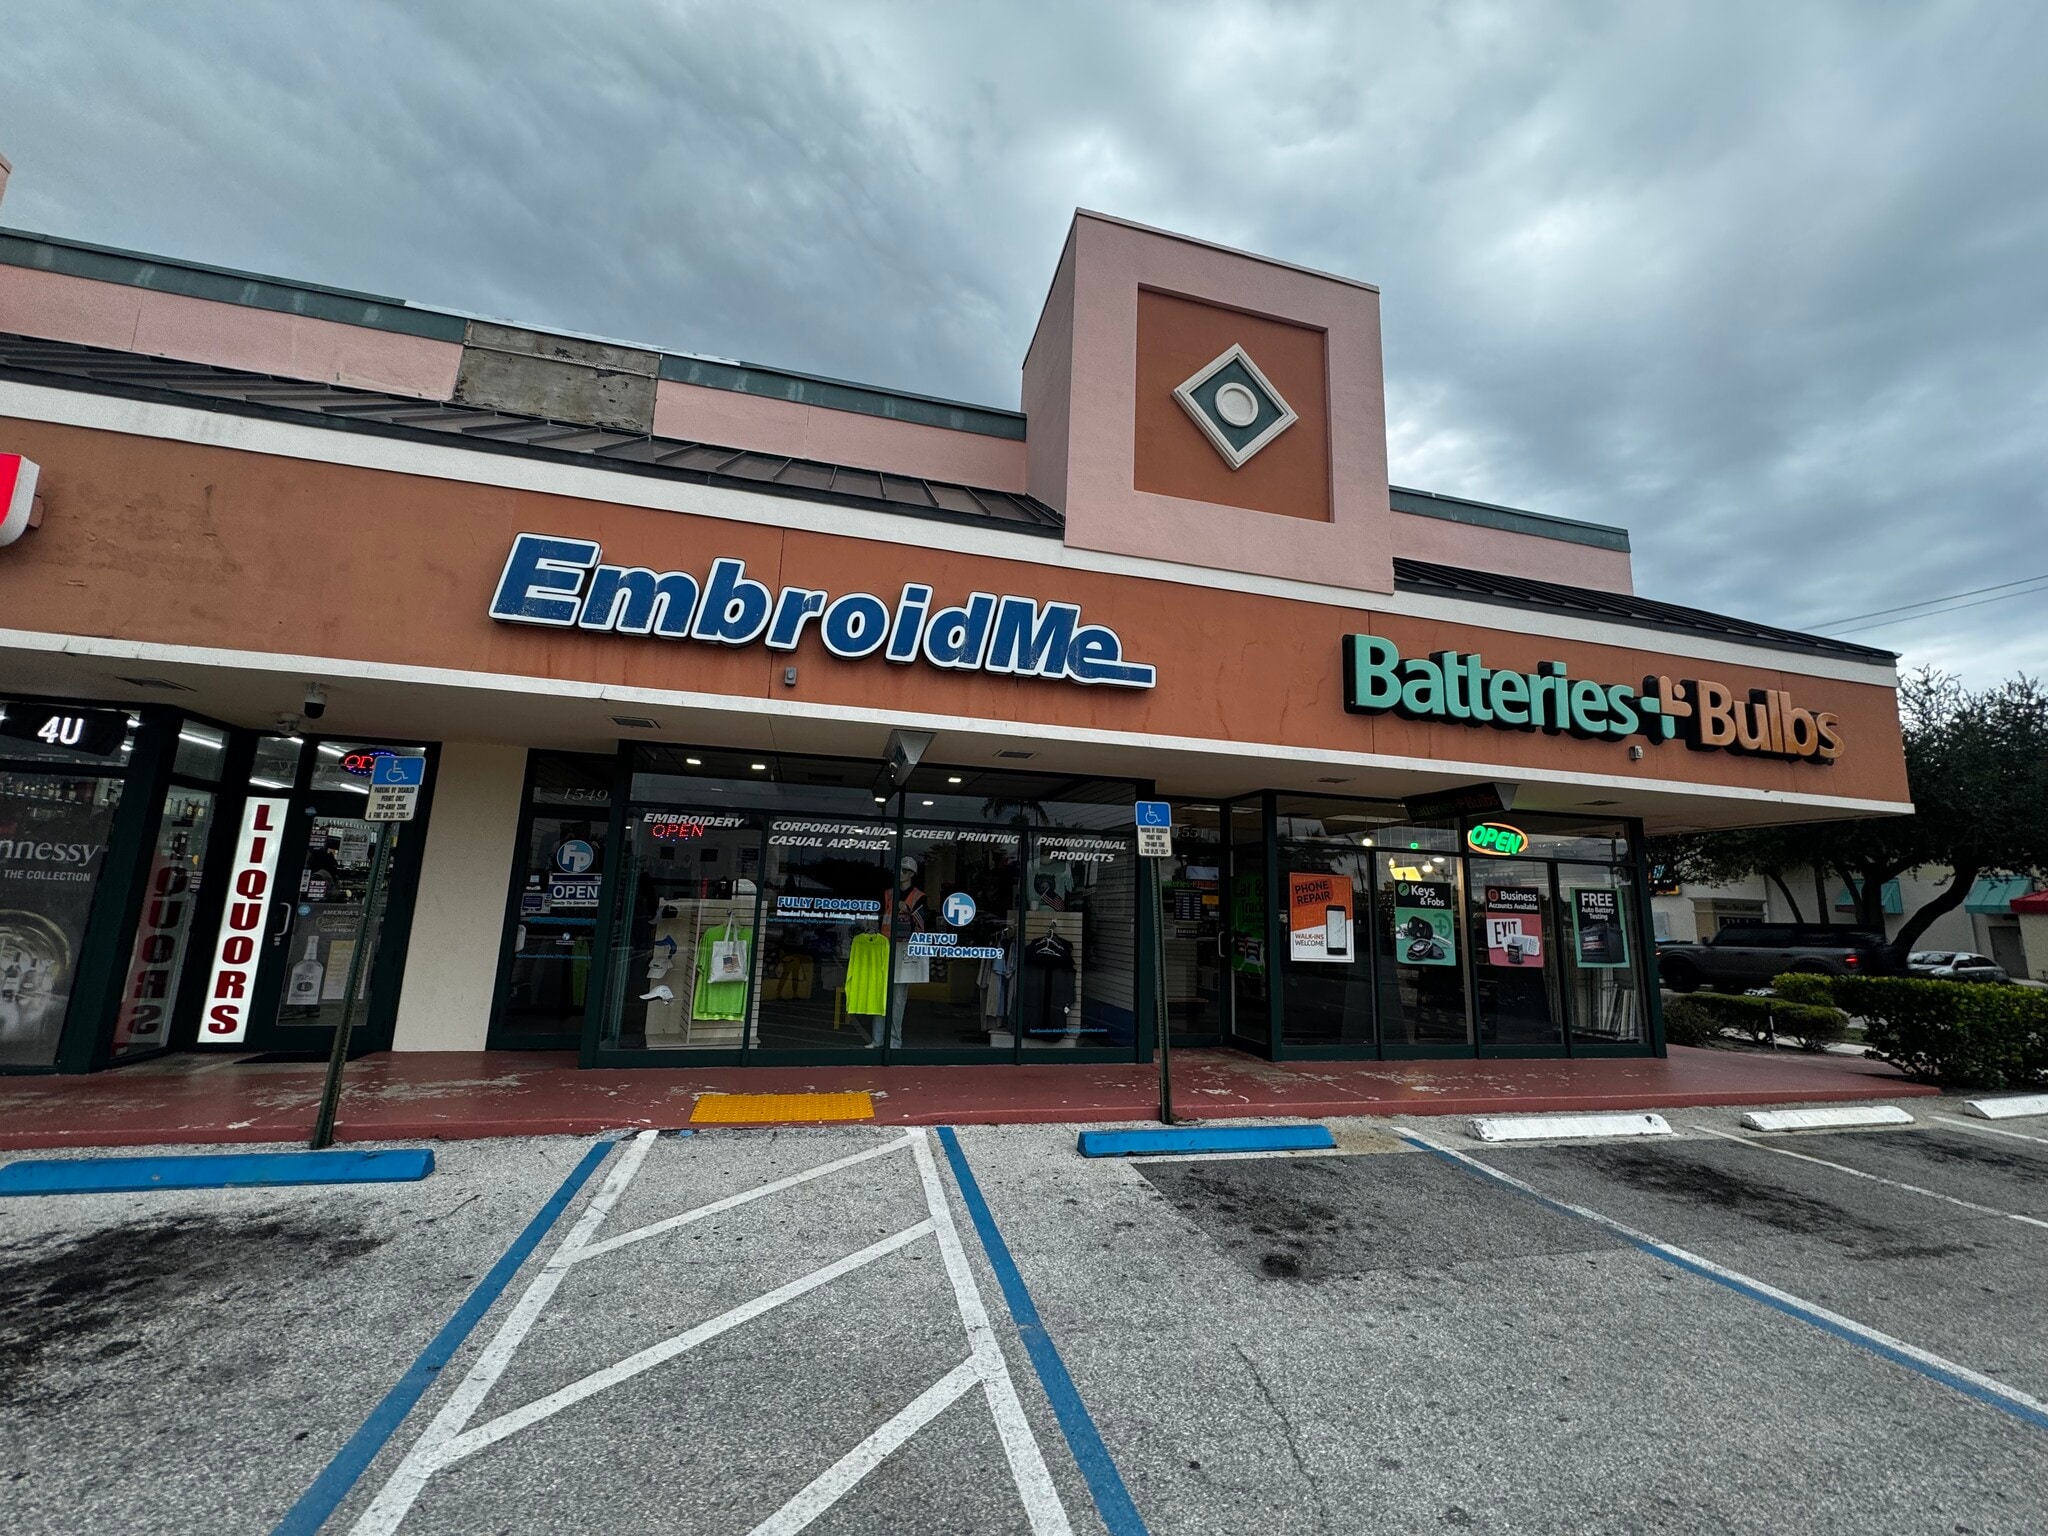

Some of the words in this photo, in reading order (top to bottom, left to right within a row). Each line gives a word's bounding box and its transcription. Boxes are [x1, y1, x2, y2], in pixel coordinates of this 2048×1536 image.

[489, 533, 1156, 689] EmbroidMe
[1346, 634, 1639, 740] Batteries
[1697, 679, 1846, 760] Bulbs
[37, 716, 84, 745] 4U
[564, 788, 608, 801] 1549
[643, 812, 745, 828] EMBROIDERY
[652, 824, 705, 838] OPEN
[772, 821, 859, 835] CORPORATE
[860, 826, 892, 837] AND
[903, 828, 956, 841] SCREEN
[957, 832, 1020, 844] PRINTING
[768, 835, 824, 847] CASUAL
[827, 838, 892, 851] APPAREL
[1037, 836, 1127, 850] PROMOTIONAL
[1471, 825, 1522, 855] OPEN
[1049, 850, 1115, 863] PRODUCTS
[4, 869, 25, 879] THE
[26, 870, 92, 882] COLLECTION
[552, 885, 598, 898] OPEN
[1294, 880, 1330, 895] PHONE
[1411, 884, 1436, 898] Keys
[1296, 891, 1331, 905] REPAIR
[1420, 898, 1426, 906] &
[1427, 898, 1445, 906] Fobs
[1500, 890, 1537, 902] Business
[1581, 892, 1614, 907] FREE
[776, 896, 814, 909] FULLY
[814, 898, 881, 912] PROMOTED
[1488, 902, 1513, 910] Accounts
[208, 804, 274, 1034] LIQUORS
[1588, 912, 1608, 921] Testing
[909, 932, 932, 944] ARE
[932, 933, 958, 945] YOU
[1294, 932, 1324, 940] WALK-INS
[1494, 921, 1518, 945] EXIT
[908, 944, 939, 957] FULLY
[940, 946, 1004, 959] PROMOTED?
